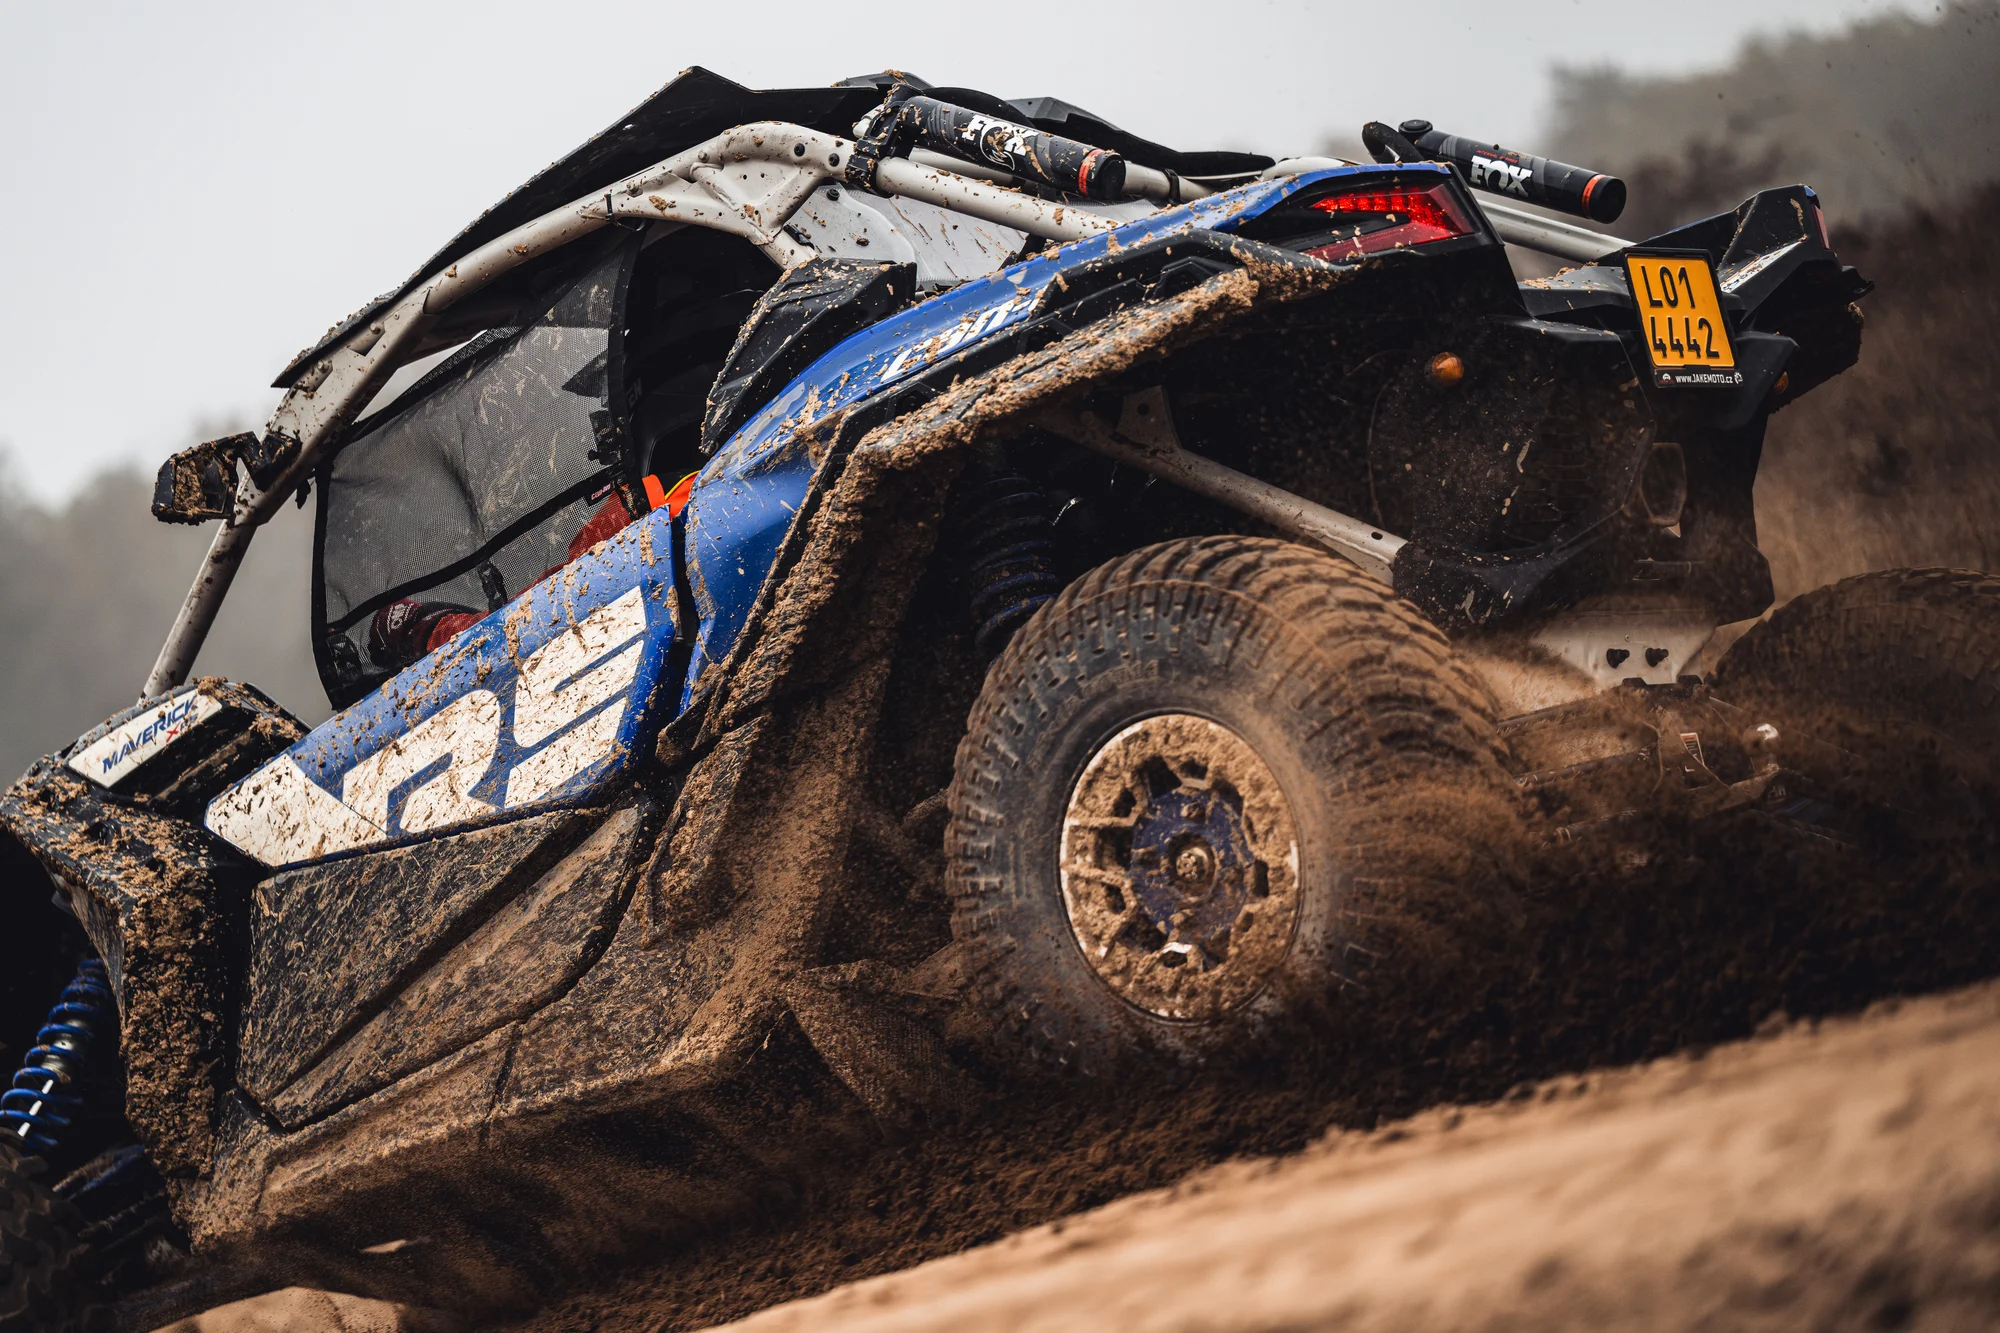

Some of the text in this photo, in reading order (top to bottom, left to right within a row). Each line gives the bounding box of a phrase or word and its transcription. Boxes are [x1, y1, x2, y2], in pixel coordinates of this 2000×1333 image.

[962, 114, 1039, 163] FOX
[1470, 155, 1533, 197] FOX
[1649, 315, 1720, 359] 4442
[1675, 373, 1733, 384] www.JAKEMOTO.cz
[103, 694, 198, 774] MAVERICK
